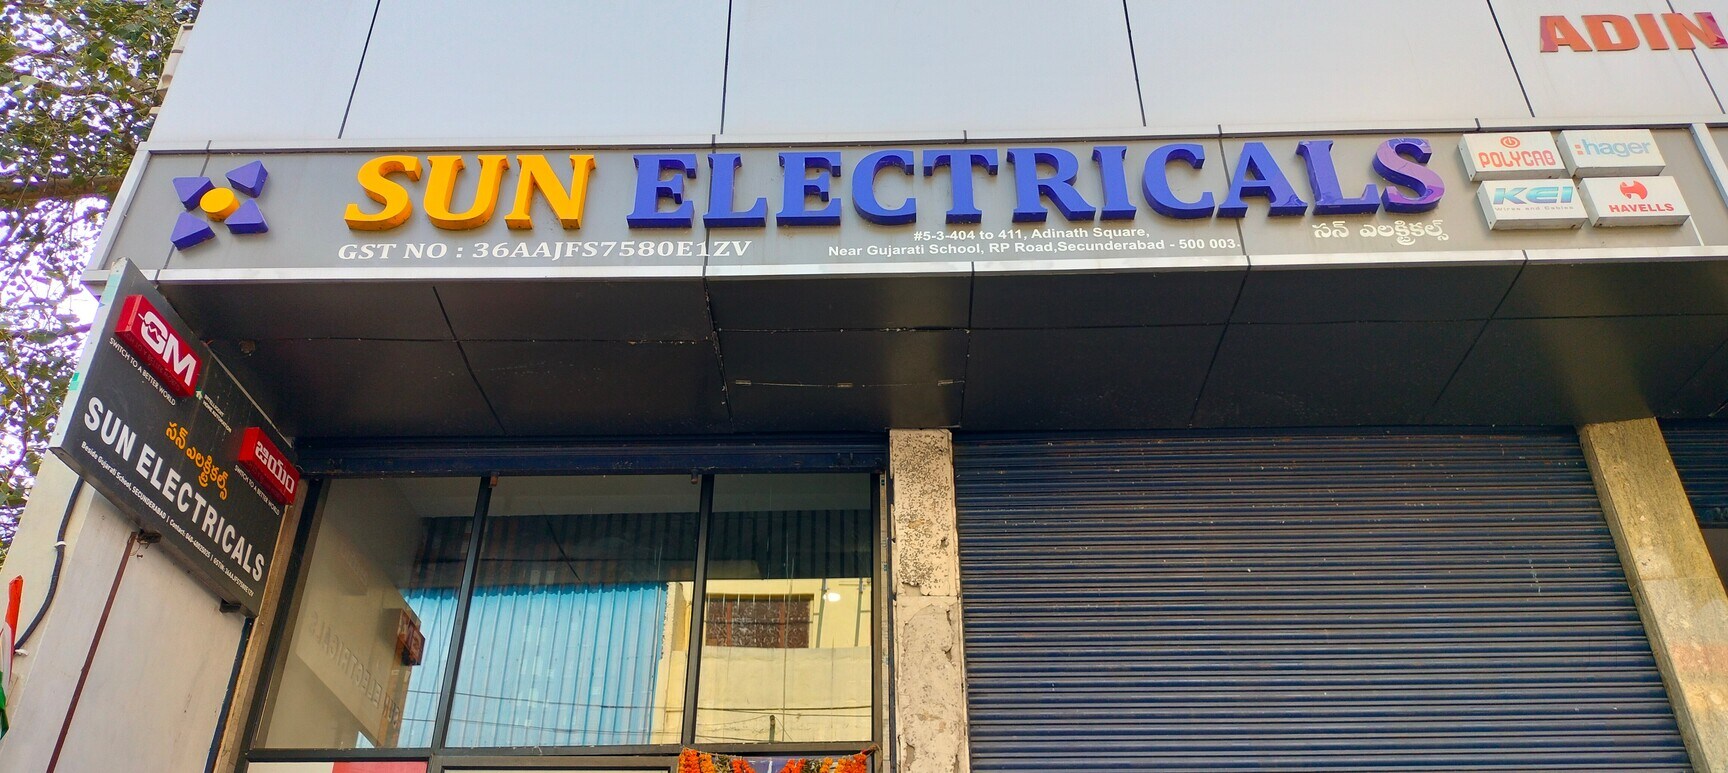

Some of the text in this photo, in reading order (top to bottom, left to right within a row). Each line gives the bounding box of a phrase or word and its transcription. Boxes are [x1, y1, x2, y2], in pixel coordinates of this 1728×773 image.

[1540, 12, 1728, 53] ADIN
[1478, 149, 1556, 168] POLYCAB
[344, 137, 1446, 230] SUN ELECTRICALS
[1493, 186, 1573, 204] KEI
[1608, 201, 1675, 213] HAVELLS
[913, 226, 1150, 241] #5-3-404 to 411, Adinath Square,
[1312, 220, 1350, 238] సన్
[338, 243, 397, 260] GST
[403, 242, 448, 259] NO
[472, 239, 752, 261] 36AAJFS7580E1ZV
[828, 245, 863, 256] Near
[866, 244, 925, 258] Gujarati
[929, 243, 985, 255] School,
[989, 242, 1011, 253] RP
[1179, 238, 1205, 249] 500
[109, 337, 130, 361] SWITCH
[130, 356, 137, 367] TO
[142, 370, 158, 389] BETTER
[158, 385, 175, 406] WORLD
[166, 422, 188, 450] సన్
[81, 441, 98, 460] Beside
[98, 455, 117, 476] Gujarati
[116, 472, 132, 491] School,
[132, 486, 166, 519] SECUNDERABAD
[83, 396, 138, 462] SUN
[136, 443, 265, 582] ELECTRICALS
